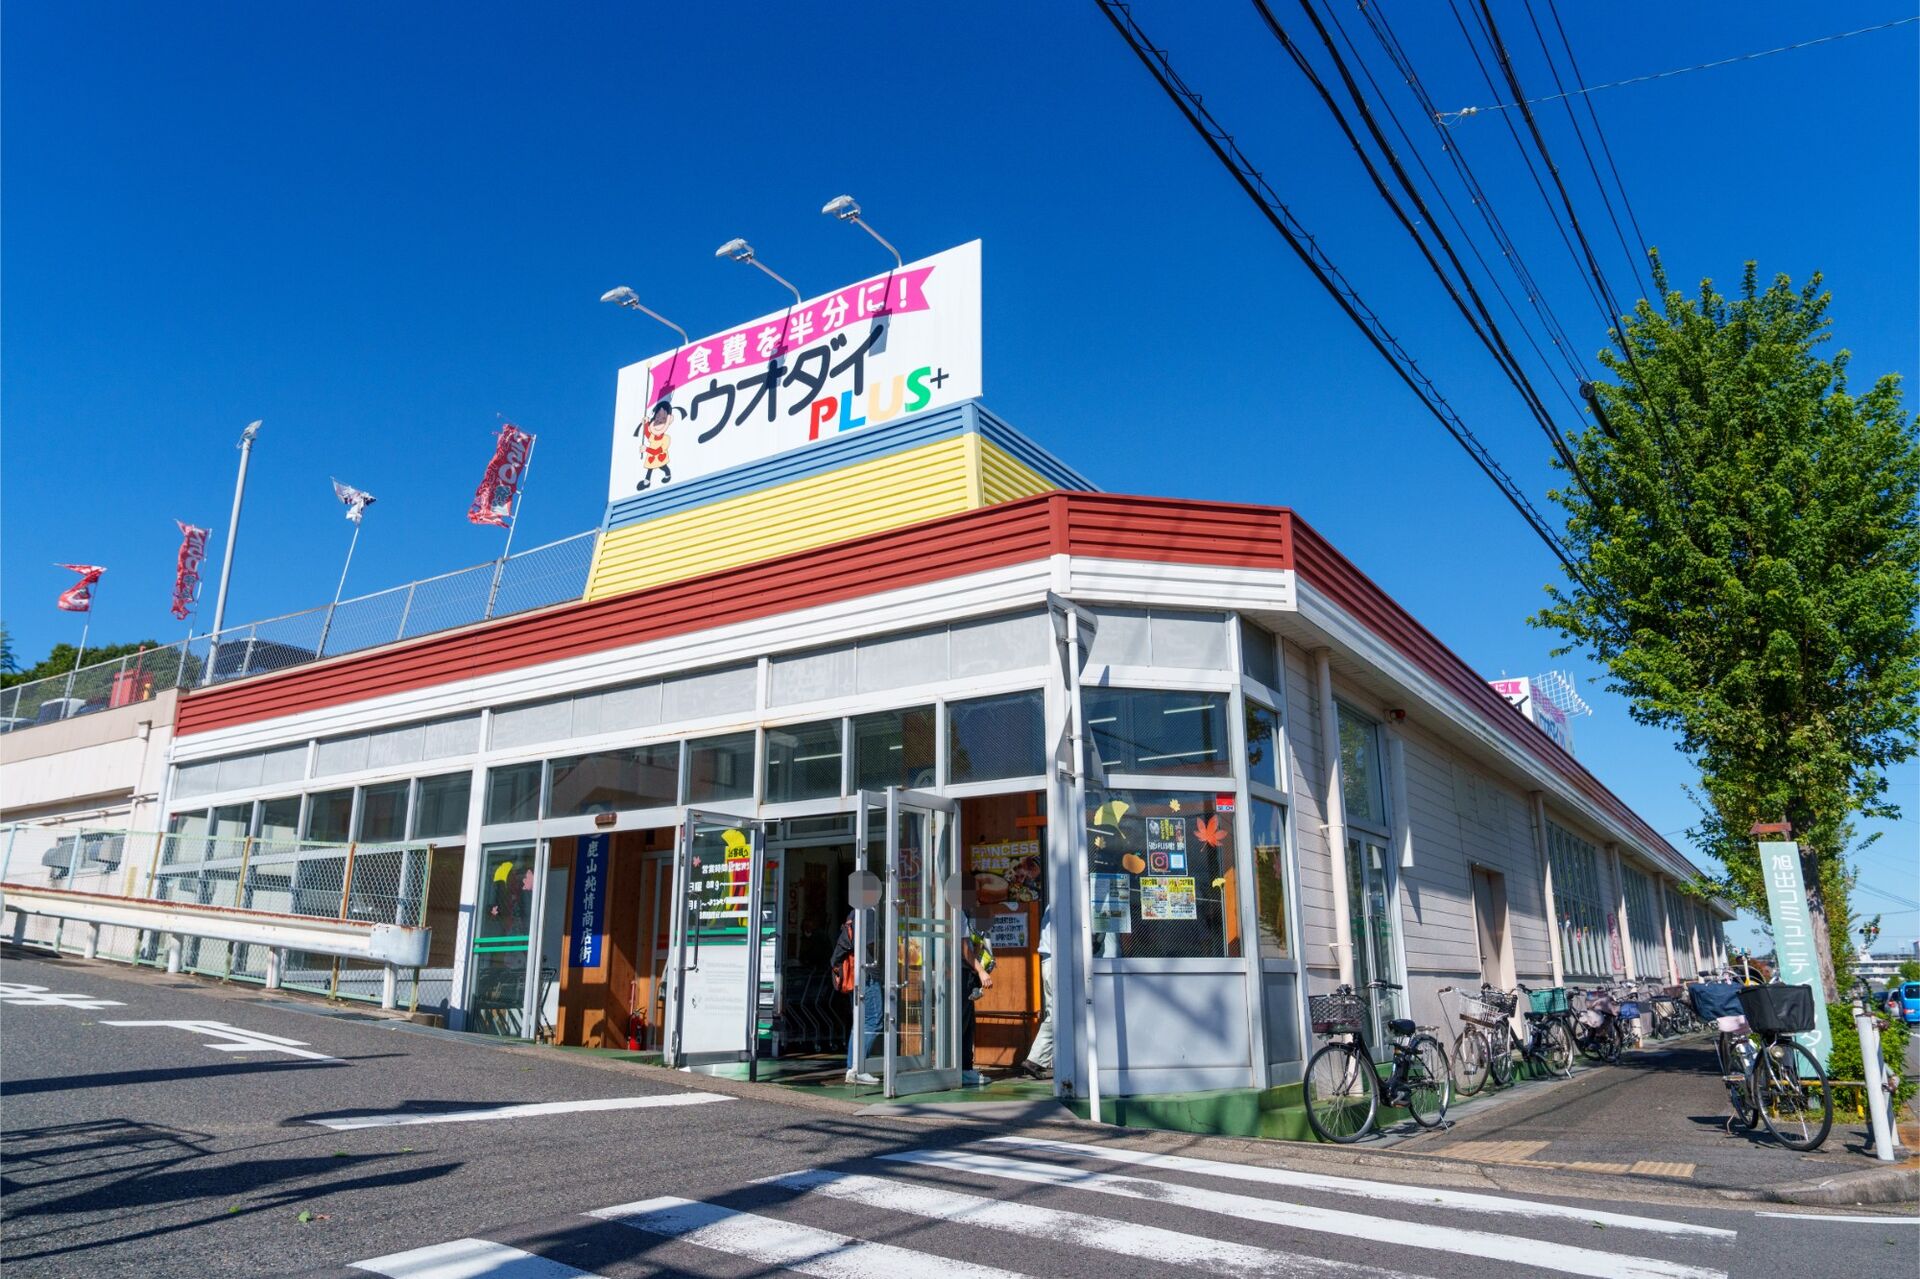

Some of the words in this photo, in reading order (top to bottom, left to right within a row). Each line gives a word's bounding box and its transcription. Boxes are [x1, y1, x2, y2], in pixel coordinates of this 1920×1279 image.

[689, 324, 884, 444] ウオダイ
[579, 841, 599, 965] 鹿山純情商店街
